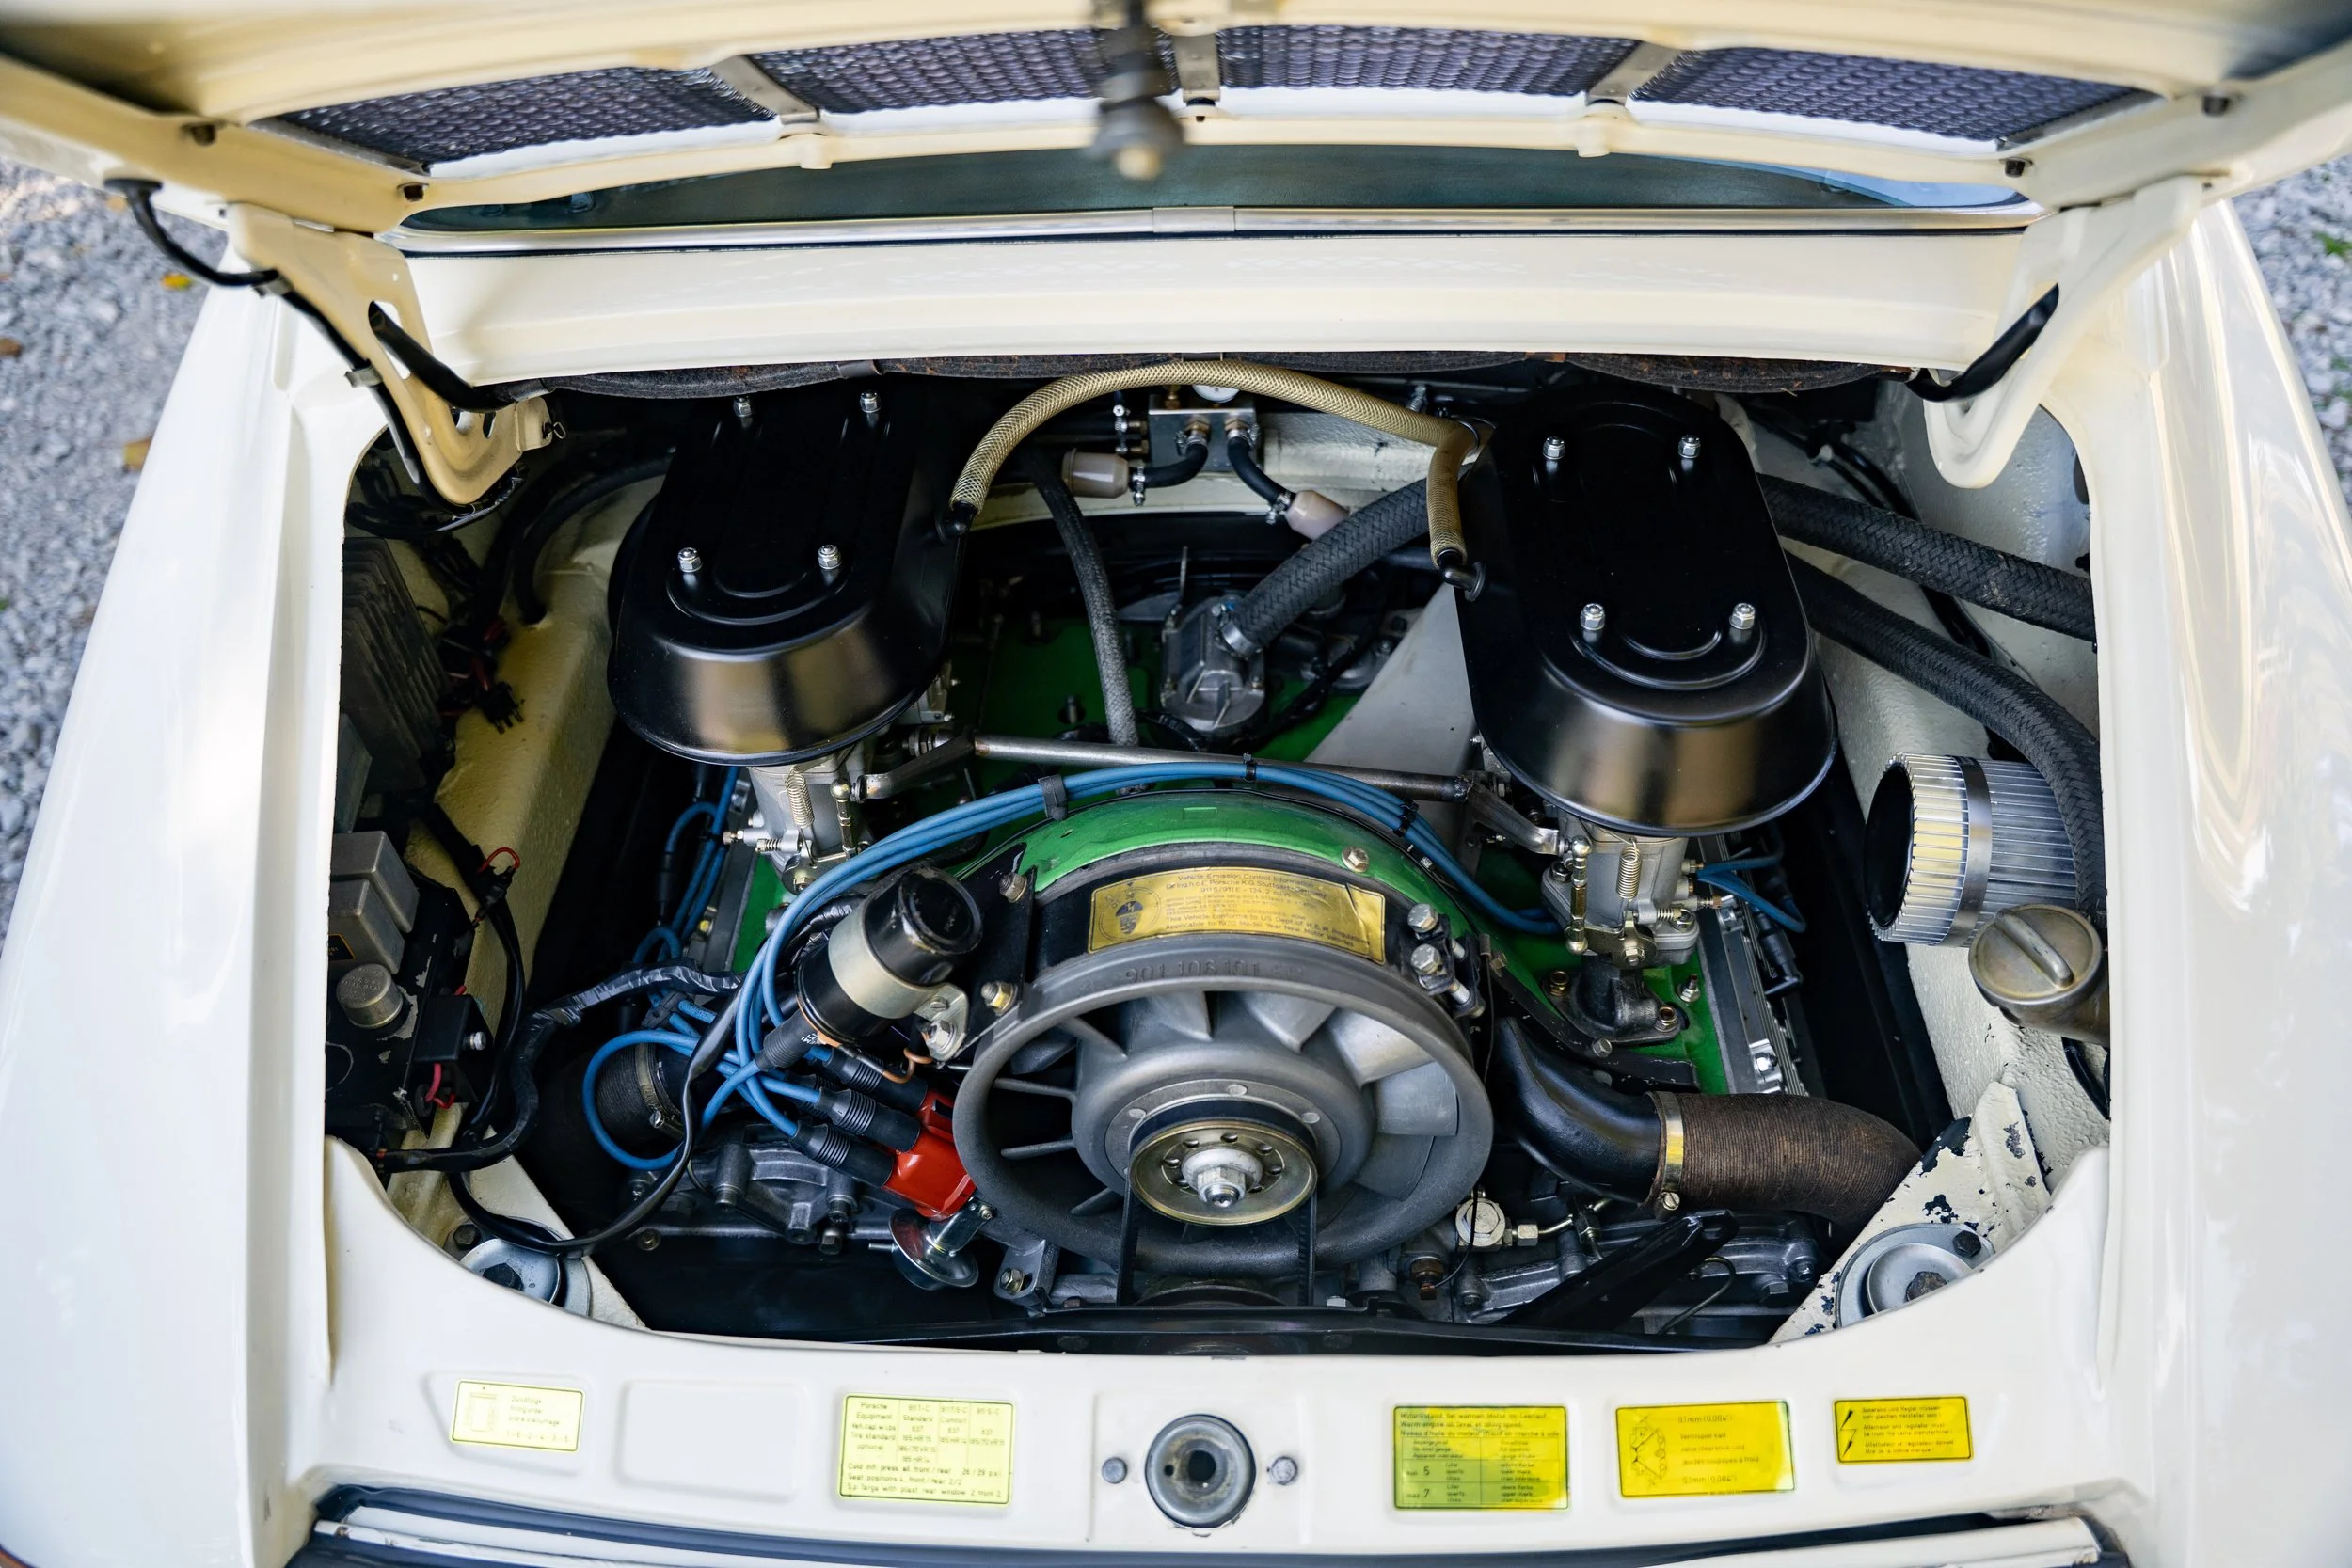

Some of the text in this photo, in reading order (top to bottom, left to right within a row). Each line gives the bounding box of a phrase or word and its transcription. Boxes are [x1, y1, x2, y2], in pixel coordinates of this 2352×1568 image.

[1243, 873, 1271, 881] Control
[1422, 1465, 1430, 1476] 5
[1423, 1488, 1430, 1498] 7
